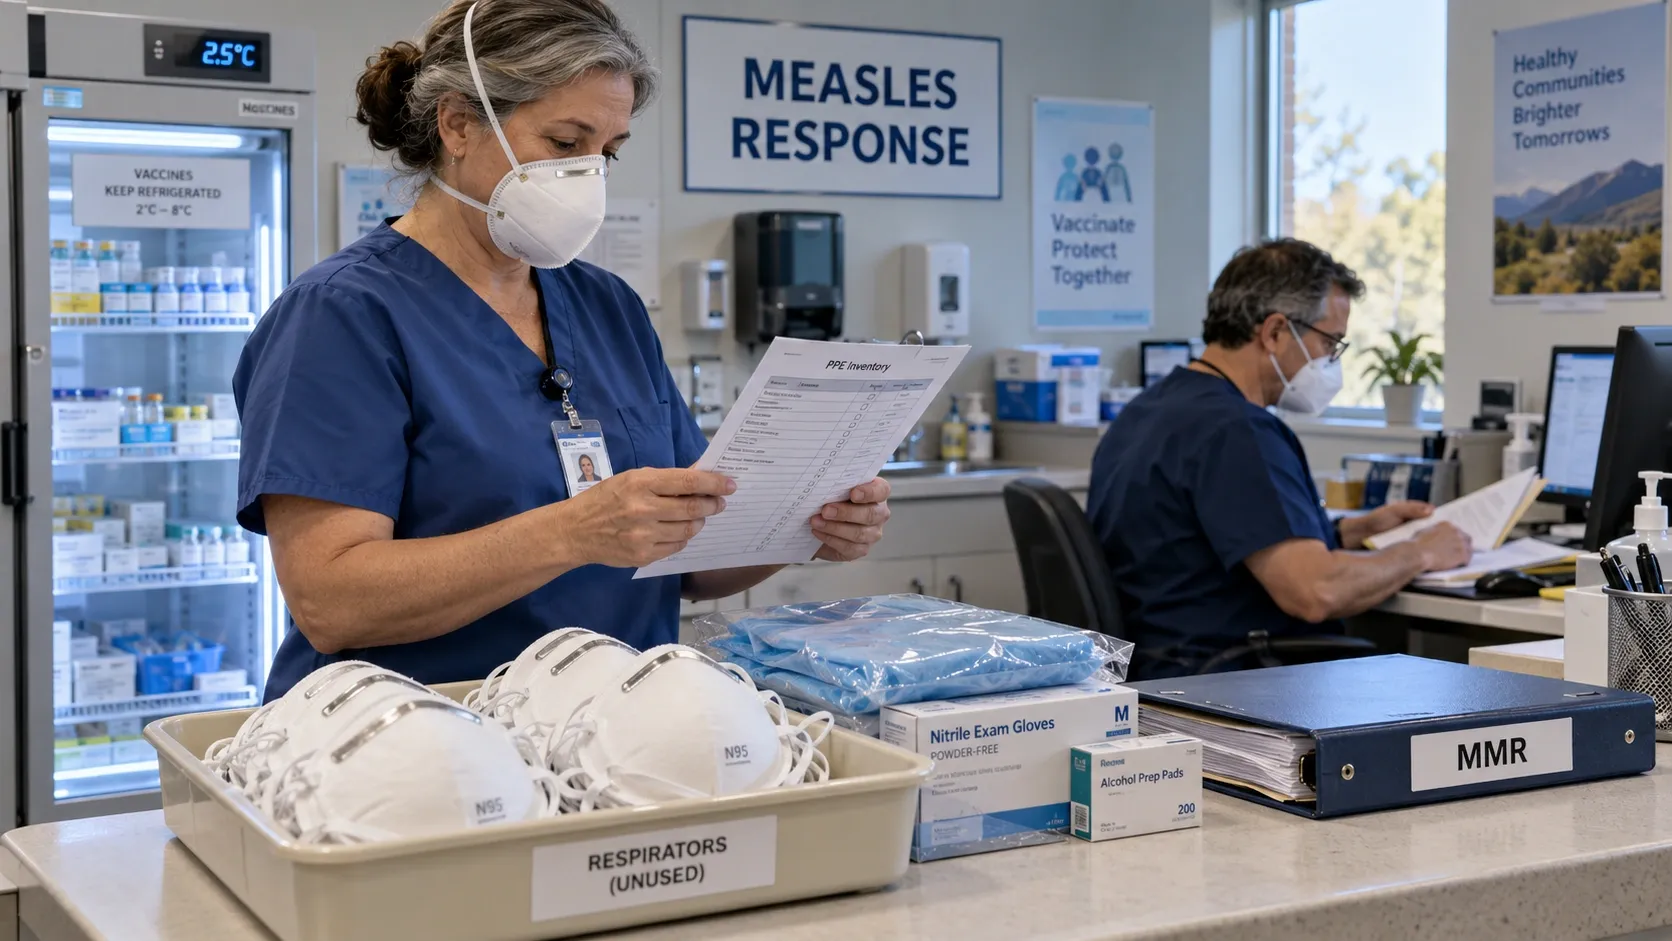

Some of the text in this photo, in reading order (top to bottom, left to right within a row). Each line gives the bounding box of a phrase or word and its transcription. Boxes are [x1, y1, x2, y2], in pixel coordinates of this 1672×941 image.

[202, 41, 255, 66] 2.5°C
[1513, 46, 1578, 74] Healthy
[744, 57, 957, 110] MEASLES
[1513, 66, 1625, 99] Communities
[1513, 101, 1582, 127] Brighter
[732, 117, 969, 166] RESPONSE
[1513, 124, 1611, 151] Tomorrows
[134, 168, 193, 181] VACCINES
[105, 185, 221, 199] KEEP REFRIGERATED
[136, 204, 156, 216] 2°C
[172, 205, 192, 216] 8°C
[1051, 213, 1136, 233] Vaccinate
[1052, 239, 1117, 260] Protect
[1052, 265, 1132, 290] Together
[825, 359, 891, 373] PPE Inventory
[1114, 704, 1129, 723] M
[930, 717, 1055, 745] Nitrile Exam Gloves
[724, 744, 749, 760] N95
[930, 743, 999, 761] POWDER-FREE
[1457, 736, 1528, 771] MMR
[1100, 767, 1184, 789] Alcohol Prep Pads
[475, 797, 503, 816] N95
[1177, 802, 1196, 815] 200
[588, 836, 728, 872] RESPIRATORS
[609, 862, 706, 897] (UNUSED)
